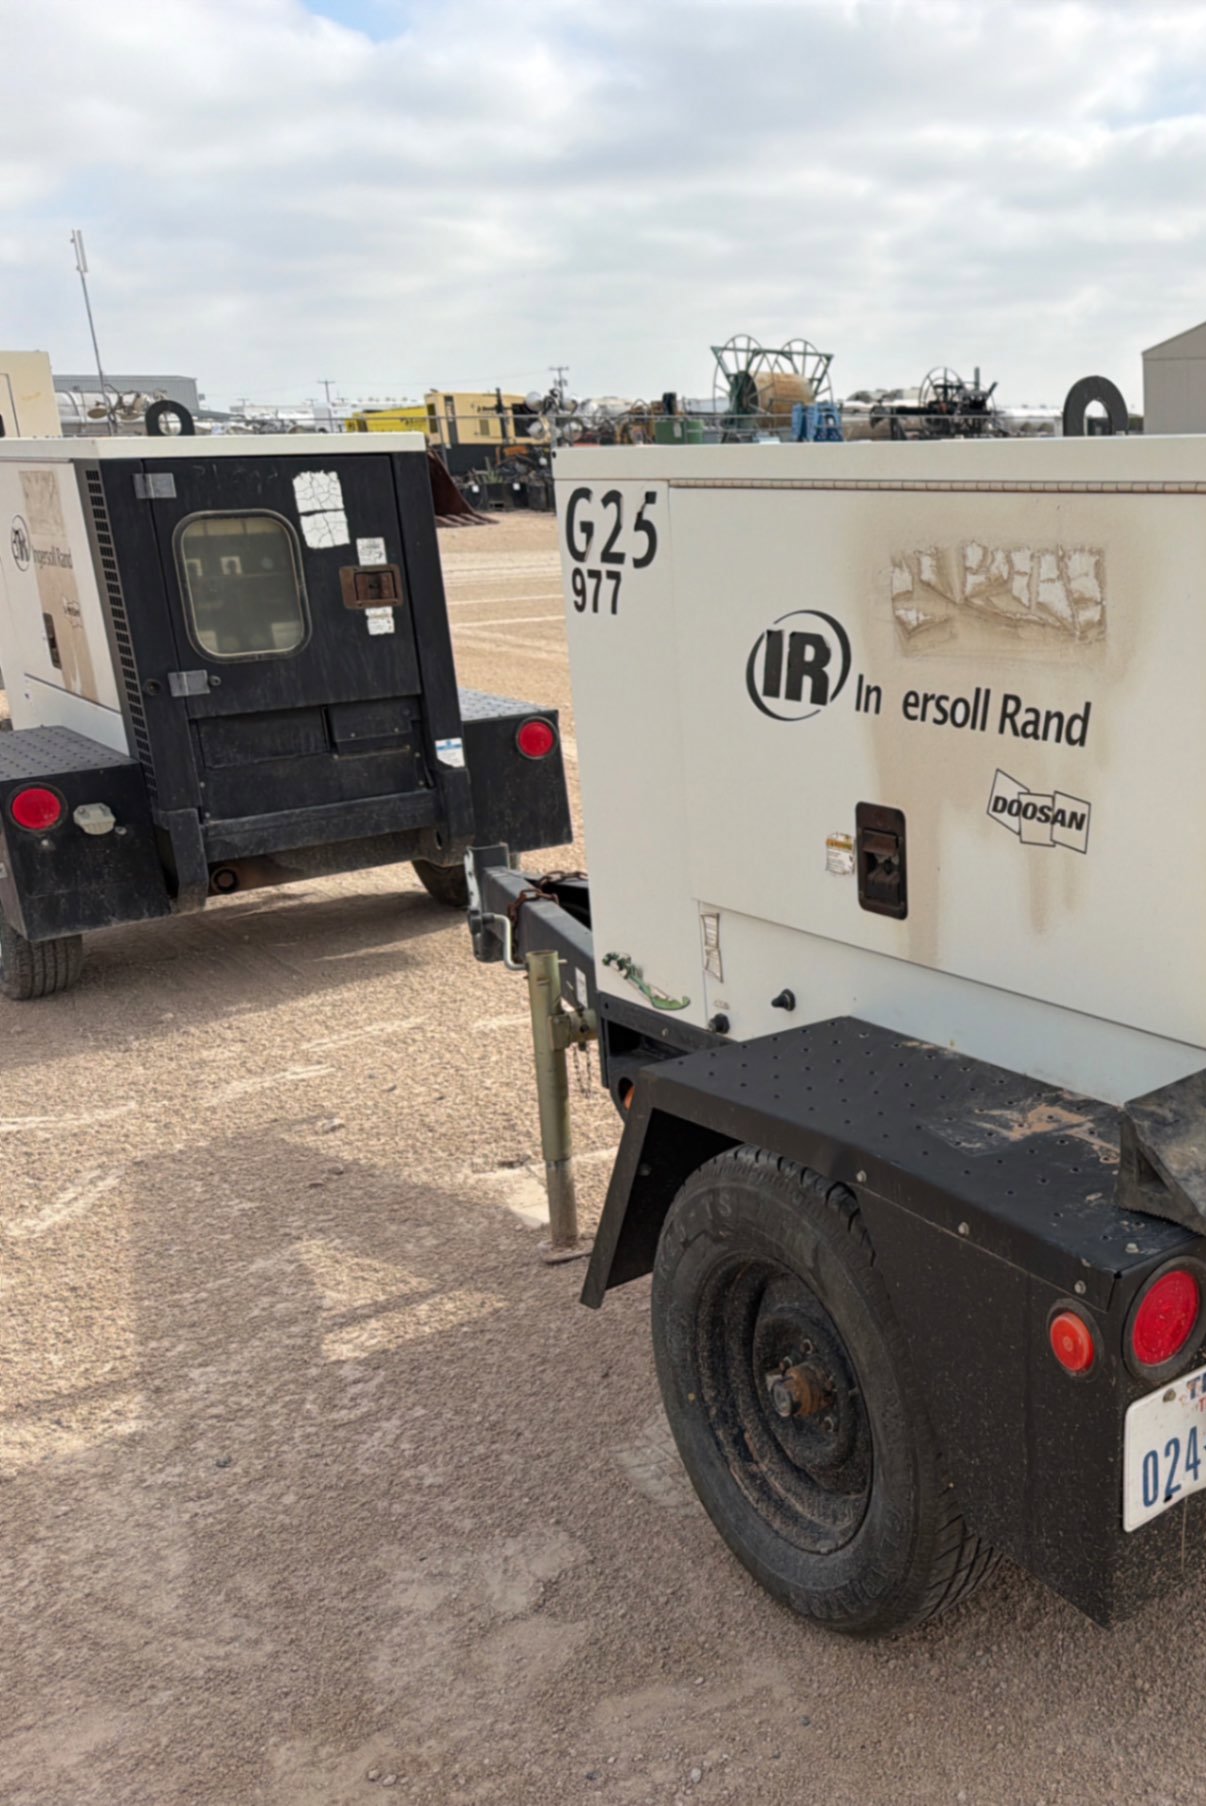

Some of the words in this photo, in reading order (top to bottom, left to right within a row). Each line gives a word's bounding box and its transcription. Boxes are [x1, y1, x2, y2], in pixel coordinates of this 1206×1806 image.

[565, 487, 658, 568] G25
[571, 570, 622, 615] 977
[762, 629, 832, 706] IR
[998, 694, 1092, 747] Rand
[992, 795, 1086, 831] DOOSAN
